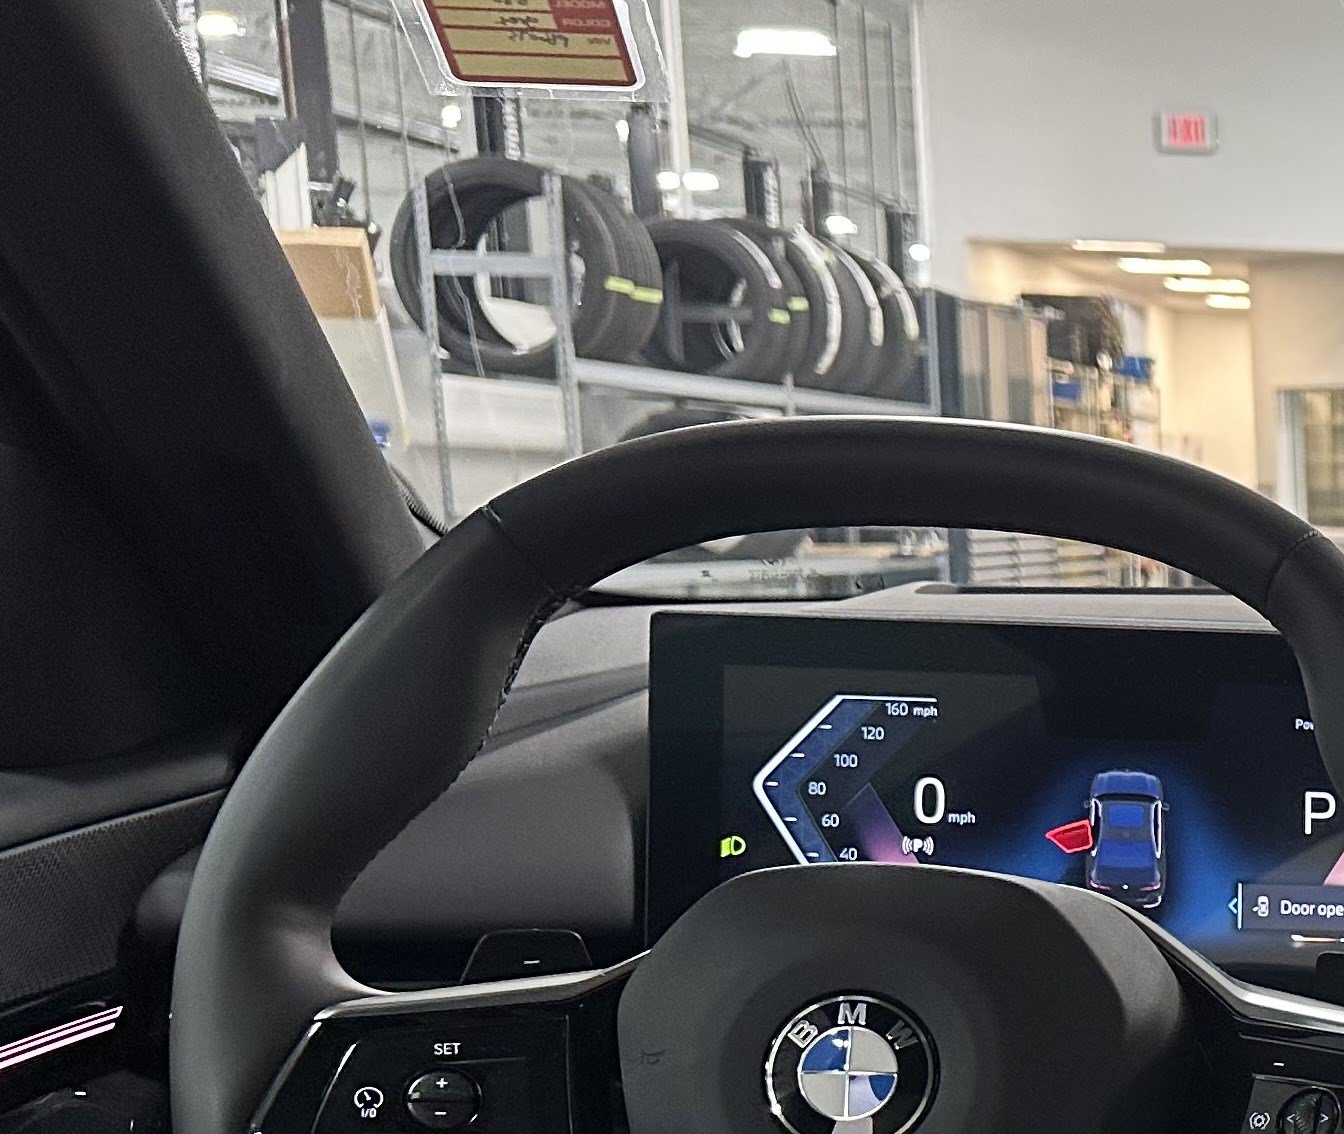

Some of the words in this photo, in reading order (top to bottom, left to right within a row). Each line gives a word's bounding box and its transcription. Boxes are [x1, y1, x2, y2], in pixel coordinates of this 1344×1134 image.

[885, 702, 909, 717] 160
[913, 706, 938, 718] mph
[861, 726, 885, 741] 120
[833, 753, 858, 768] 100
[808, 781, 827, 796] 80
[913, 776, 946, 824] 0
[948, 811, 976, 825] mph
[1304, 790, 1337, 835] P
[821, 813, 840, 828] 60
[839, 847, 858, 861] 40
[1280, 899, 1315, 916] Door
[787, 1002, 919, 1051] BMW
[433, 1042, 462, 1056] SET
